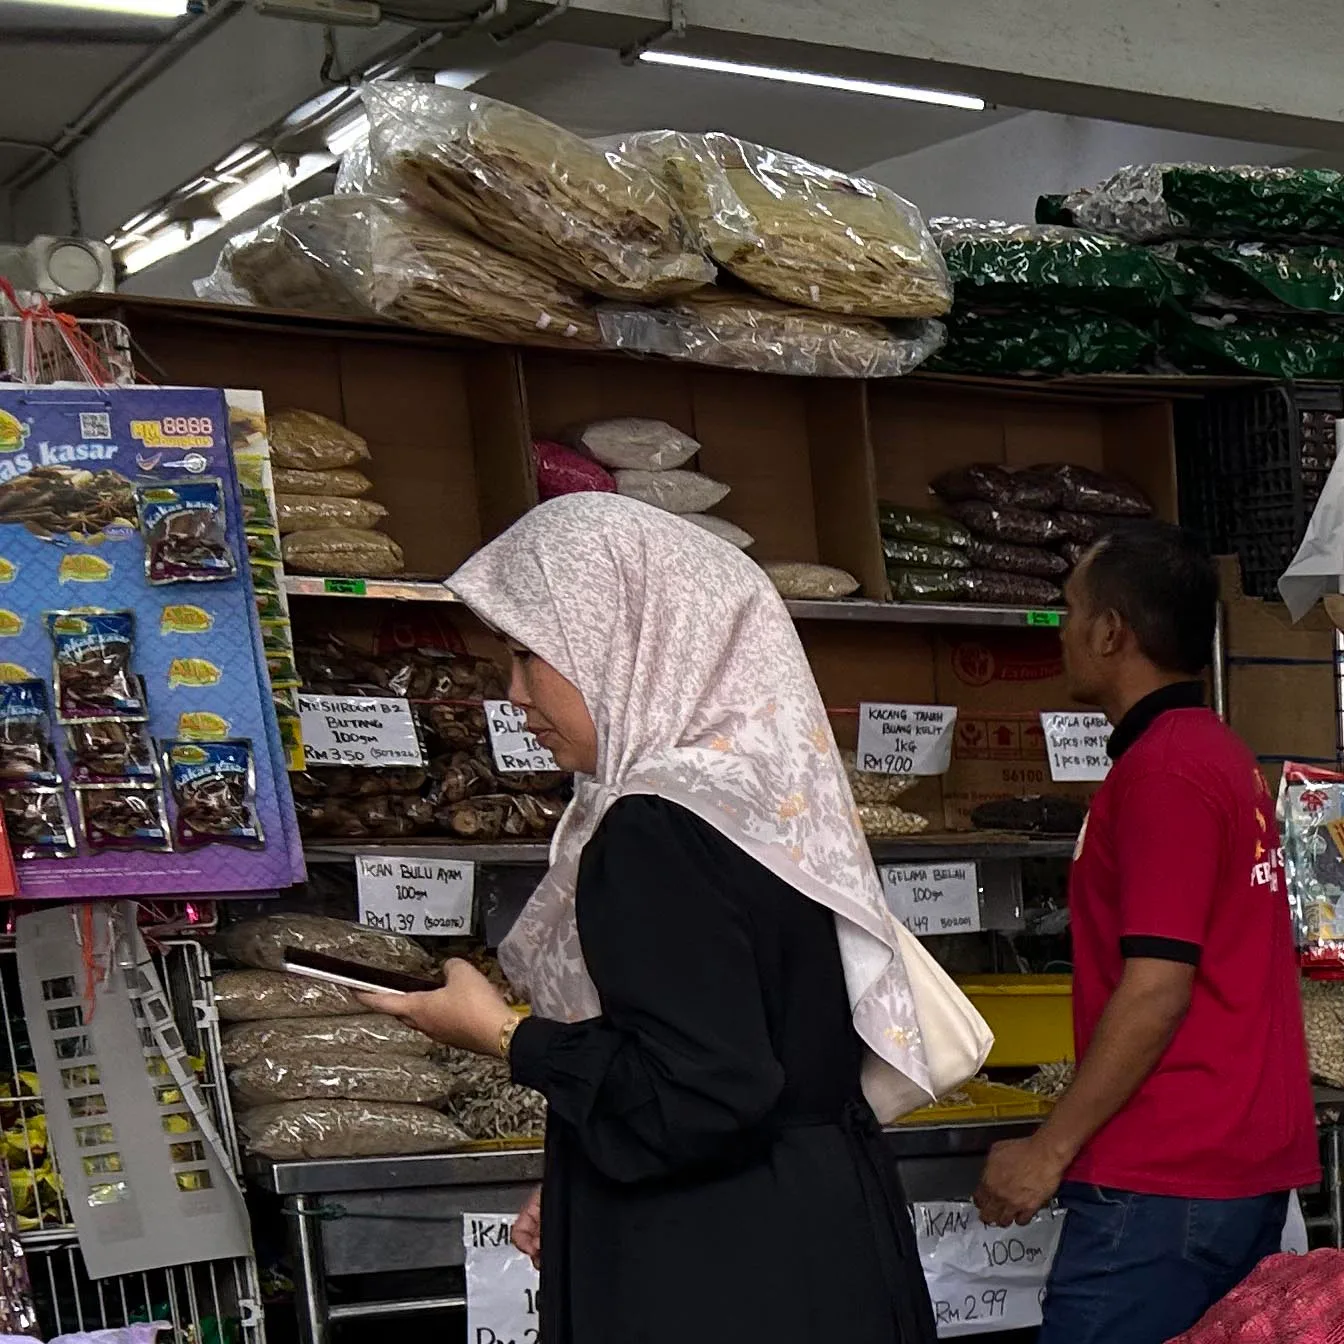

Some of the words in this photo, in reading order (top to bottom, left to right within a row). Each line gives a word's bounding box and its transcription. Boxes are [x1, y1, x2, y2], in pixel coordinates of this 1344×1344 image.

[38, 441, 118, 466] kasar
[868, 707, 907, 722] KACANG
[360, 860, 393, 877] IKAN
[400, 864, 433, 880] BULU
[888, 870, 927, 884] GELAMA
[933, 870, 965, 882] BELAH
[924, 1211, 970, 1237] IKAN
[982, 1239, 1042, 1267] 100gm
